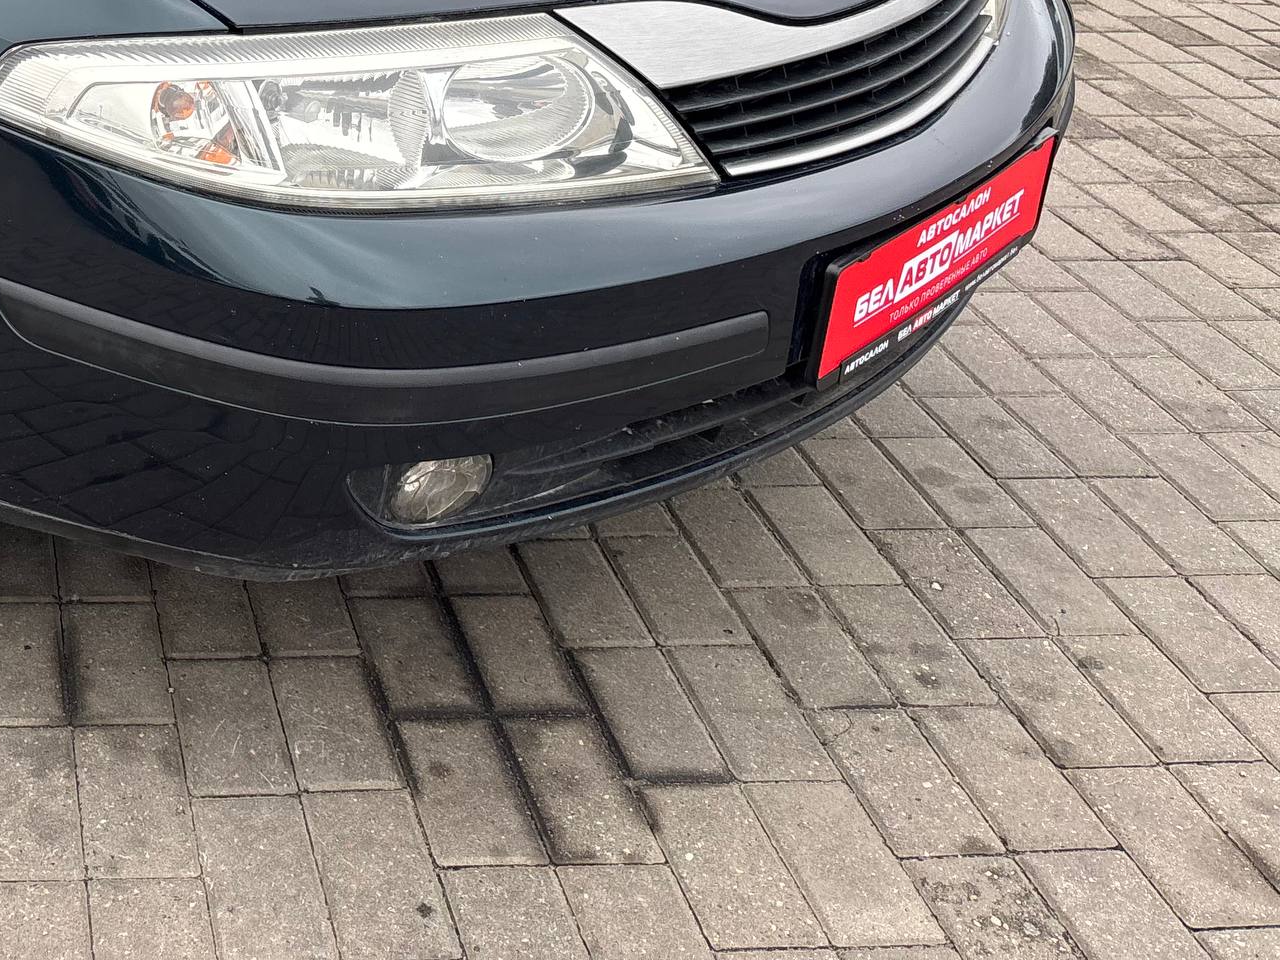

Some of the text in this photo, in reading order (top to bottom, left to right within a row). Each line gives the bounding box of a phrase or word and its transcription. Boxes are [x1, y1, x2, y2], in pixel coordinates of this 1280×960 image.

[916, 186, 992, 248] АВТОСАЛОН
[889, 296, 920, 323] ТОЛЬКО
[920, 261, 972, 302] ПРОВЕРЕННЫЕ
[971, 247, 988, 267] АВТО
[844, 339, 889, 375] АВТОСАЛОН
